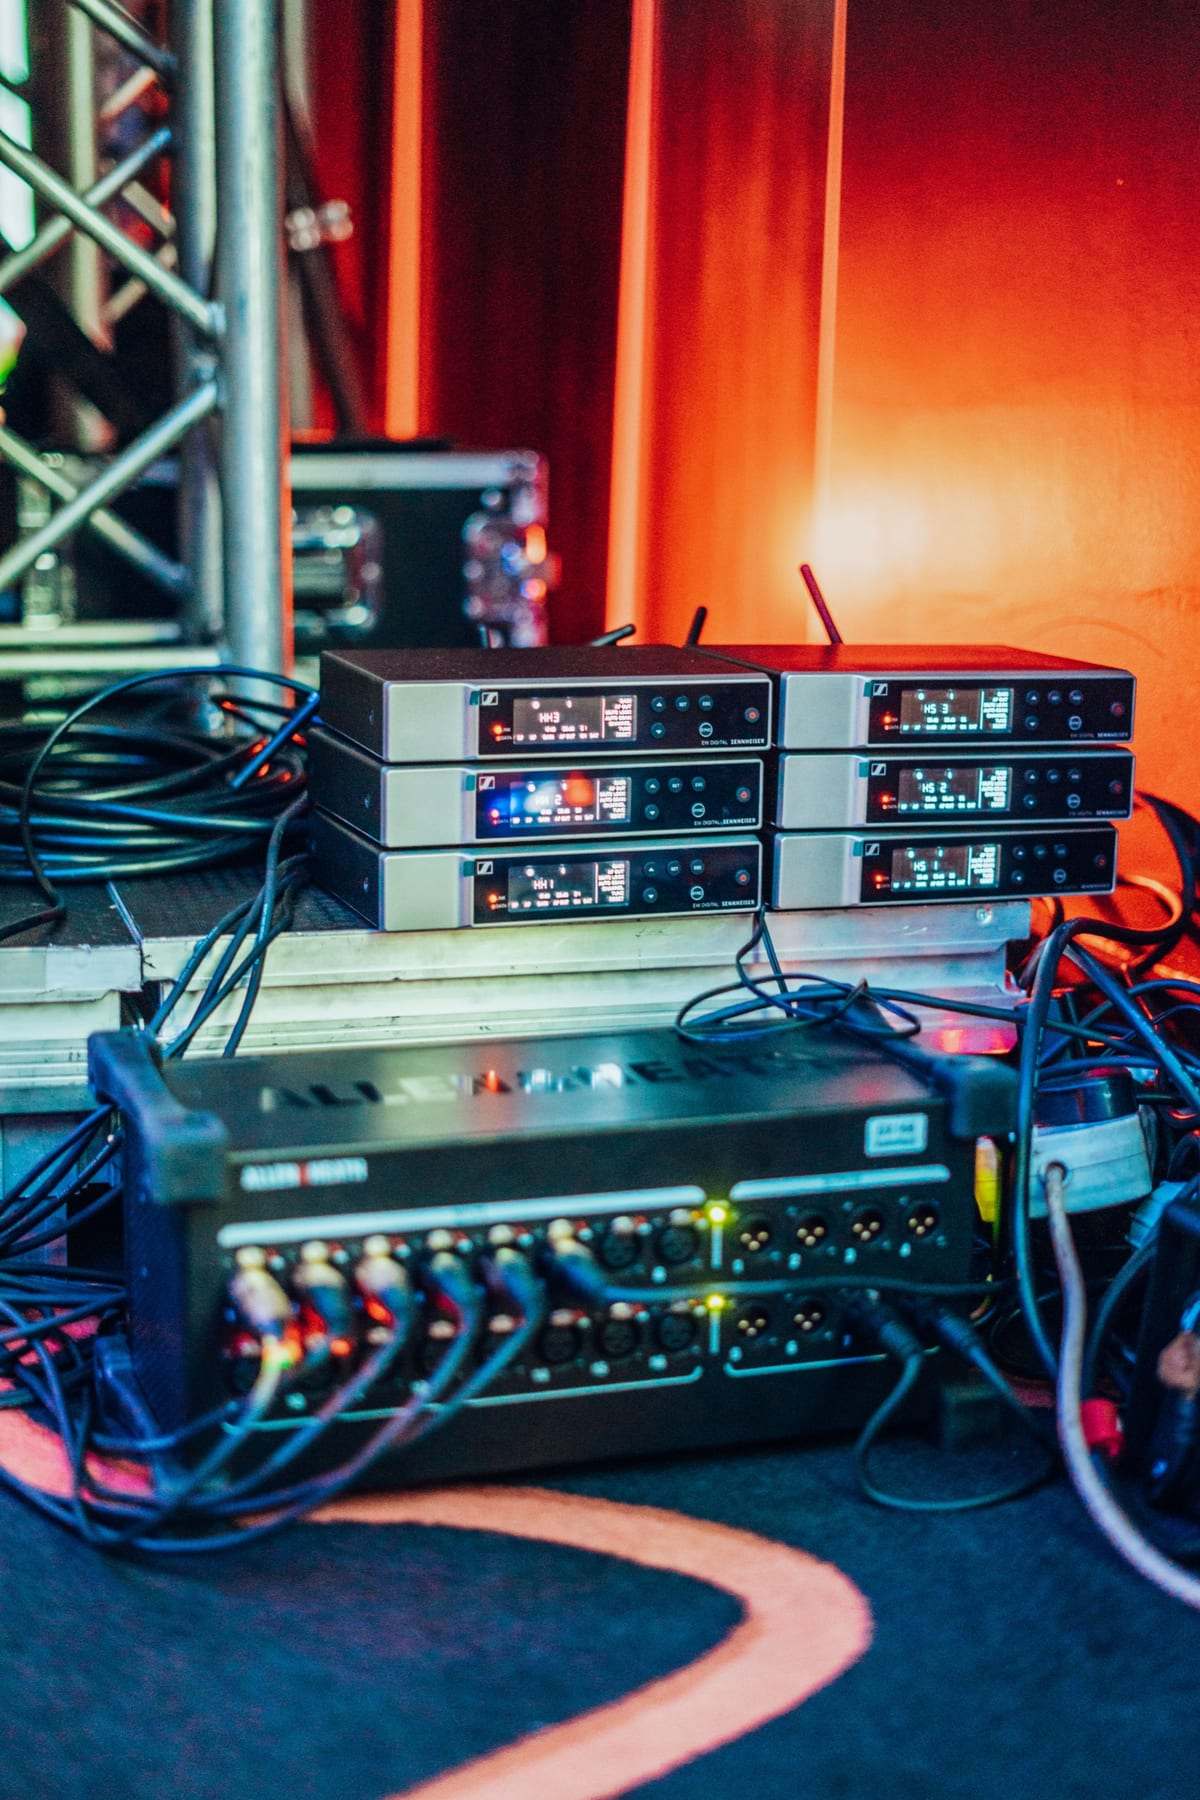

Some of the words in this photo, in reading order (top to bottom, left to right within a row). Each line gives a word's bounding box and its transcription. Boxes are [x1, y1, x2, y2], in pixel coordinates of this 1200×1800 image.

[942, 703, 949, 714] 3
[539, 711, 560, 723] HH3
[940, 782, 948, 793] 2
